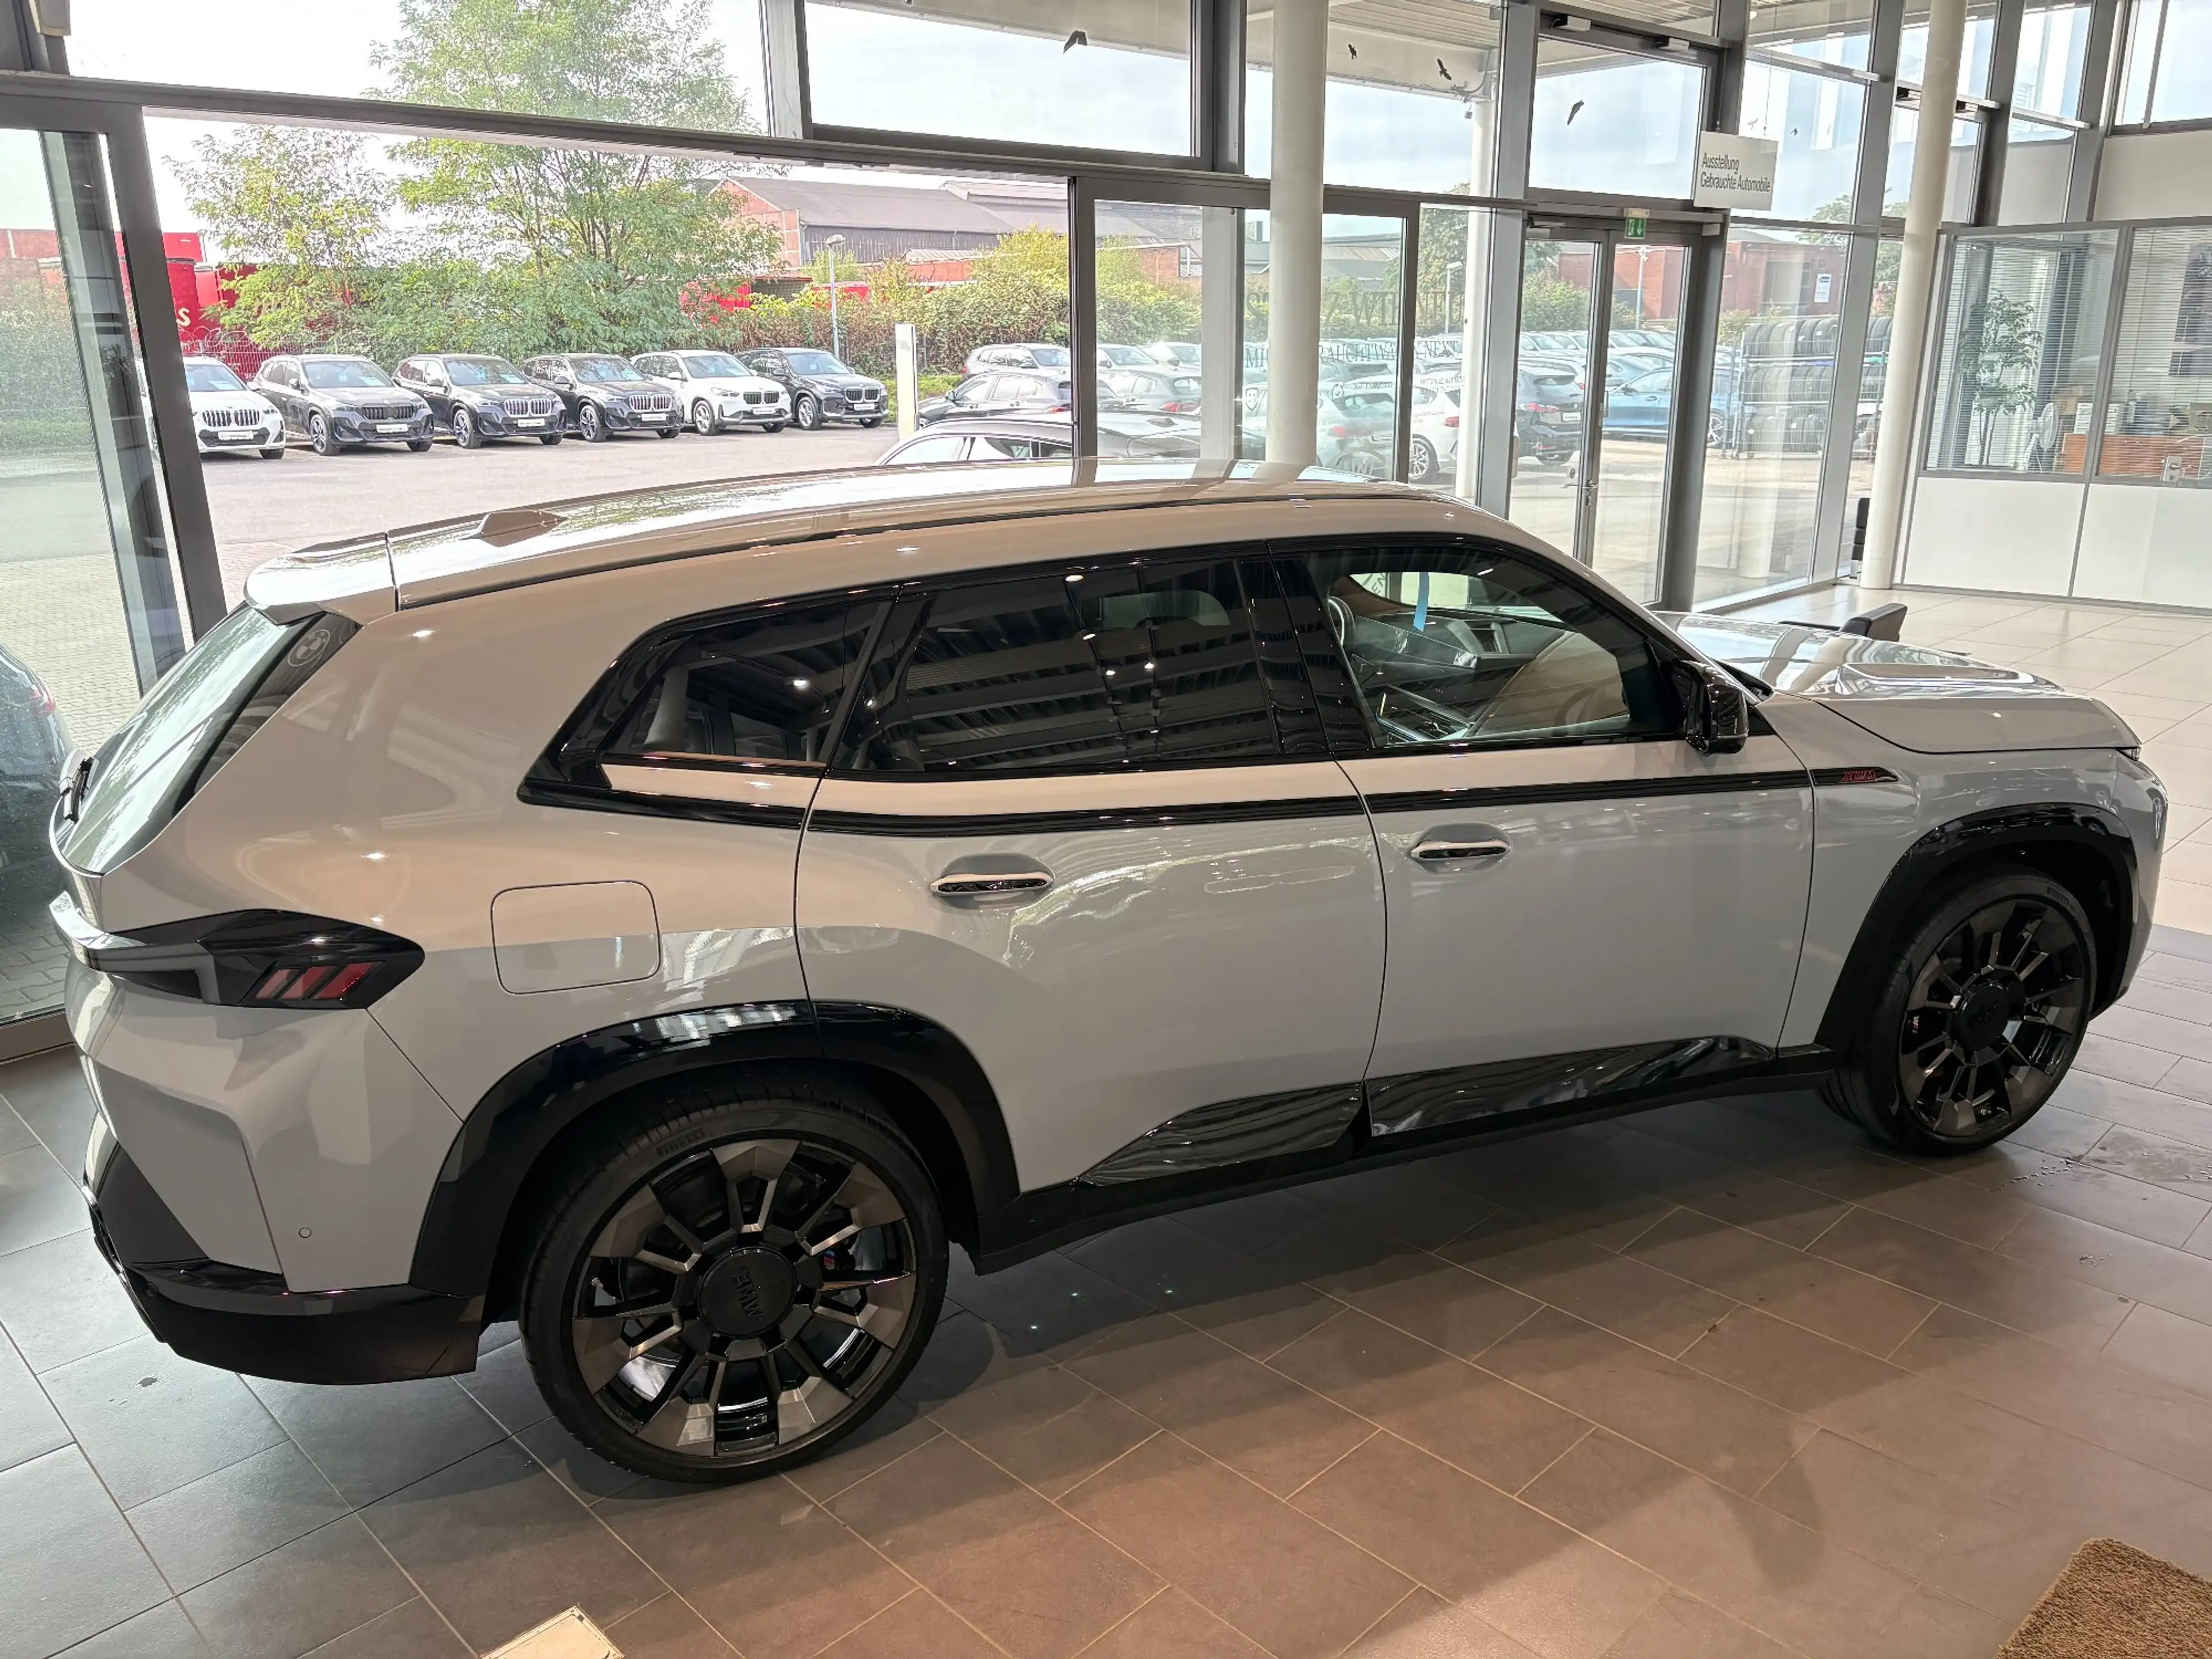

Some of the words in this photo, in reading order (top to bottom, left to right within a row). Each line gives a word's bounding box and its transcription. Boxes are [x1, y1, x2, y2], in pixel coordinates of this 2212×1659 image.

[1701, 152, 1740, 175] Ausstellung
[1700, 172, 1737, 190] Gebrauchte
[1737, 175, 1771, 193] Automobile
